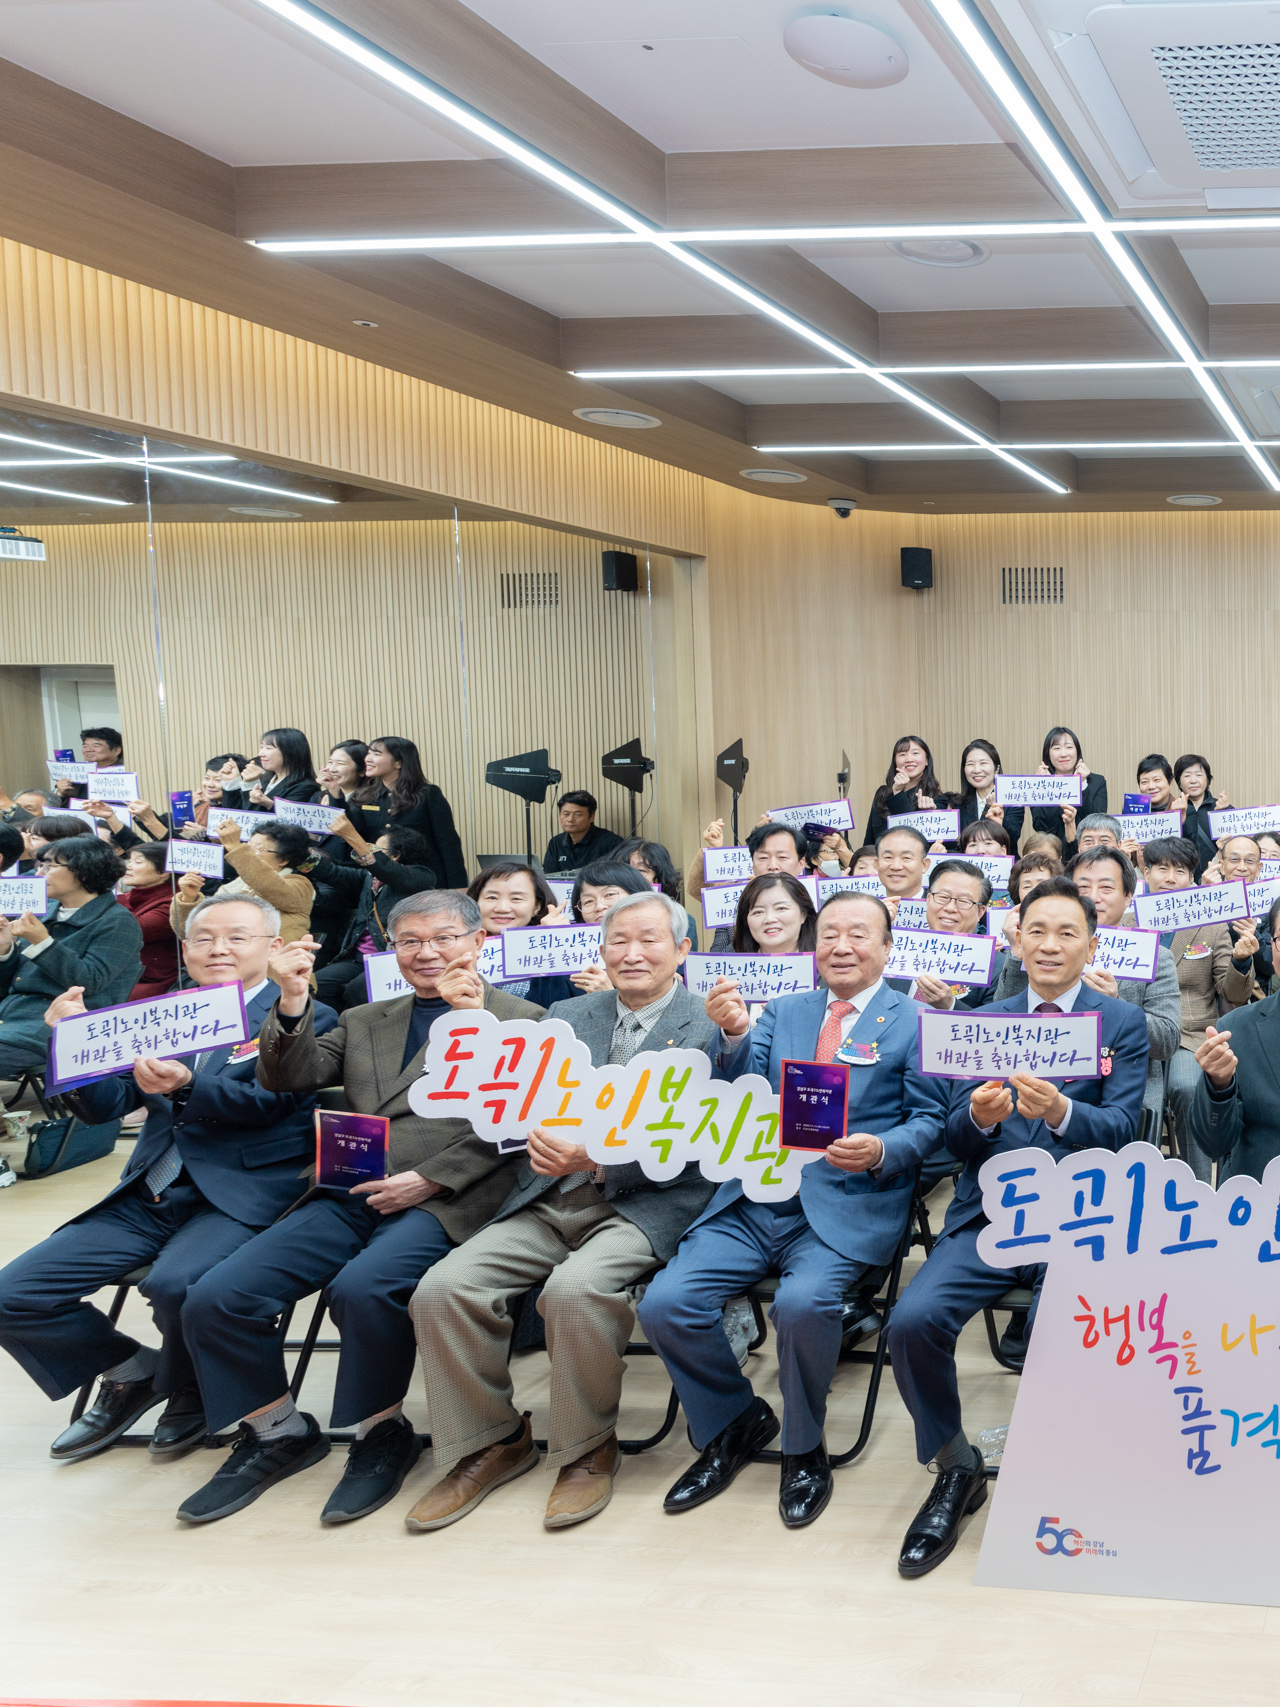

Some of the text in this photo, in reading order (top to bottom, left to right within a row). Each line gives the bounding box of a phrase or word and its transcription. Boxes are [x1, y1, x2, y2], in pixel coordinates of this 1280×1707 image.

[1011, 780, 1068, 791] 도곡1노인복지관
[1004, 791, 1078, 803] 개관을 축하합니다
[784, 808, 836, 821] 도곡1노인복지관
[815, 817, 849, 827] 합니다
[1122, 818, 1169, 829] 곡1노인복지관
[1222, 811, 1272, 823] 도곡1노인복지관
[920, 825, 956, 837] 합니다
[1240, 820, 1280, 832] 축하합니다
[723, 852, 752, 864] 도곡1노
[1155, 891, 1229, 912] 도곡1노인복지관
[1148, 902, 1244, 928] 개관을 축하합니다
[528, 931, 601, 951] 도곡1노인복지
[891, 936, 972, 957] 곡1노인복지관
[517, 952, 556, 968] 개관을
[561, 949, 601, 968] 축하합
[886, 954, 985, 975] 관을 축하합니다
[1091, 952, 1150, 970] 합니다
[705, 961, 793, 978] 도곡1노인복지관
[86, 1002, 210, 1041] 도곡1노인복지관
[71, 1019, 238, 1066] 개관을 축하합니다
[950, 1023, 1070, 1047] 도곡1노인복지관
[936, 1048, 984, 1071] 개관을
[990, 1047, 1093, 1071] 축하합니다
[427, 1027, 791, 1186] 도곡1노인복지관
[1073, 1292, 1202, 1381] 행복을
[1073, 1539, 1104, 1548] 혁신의 강남
[1085, 1548, 1117, 1557] 미래의 중심
